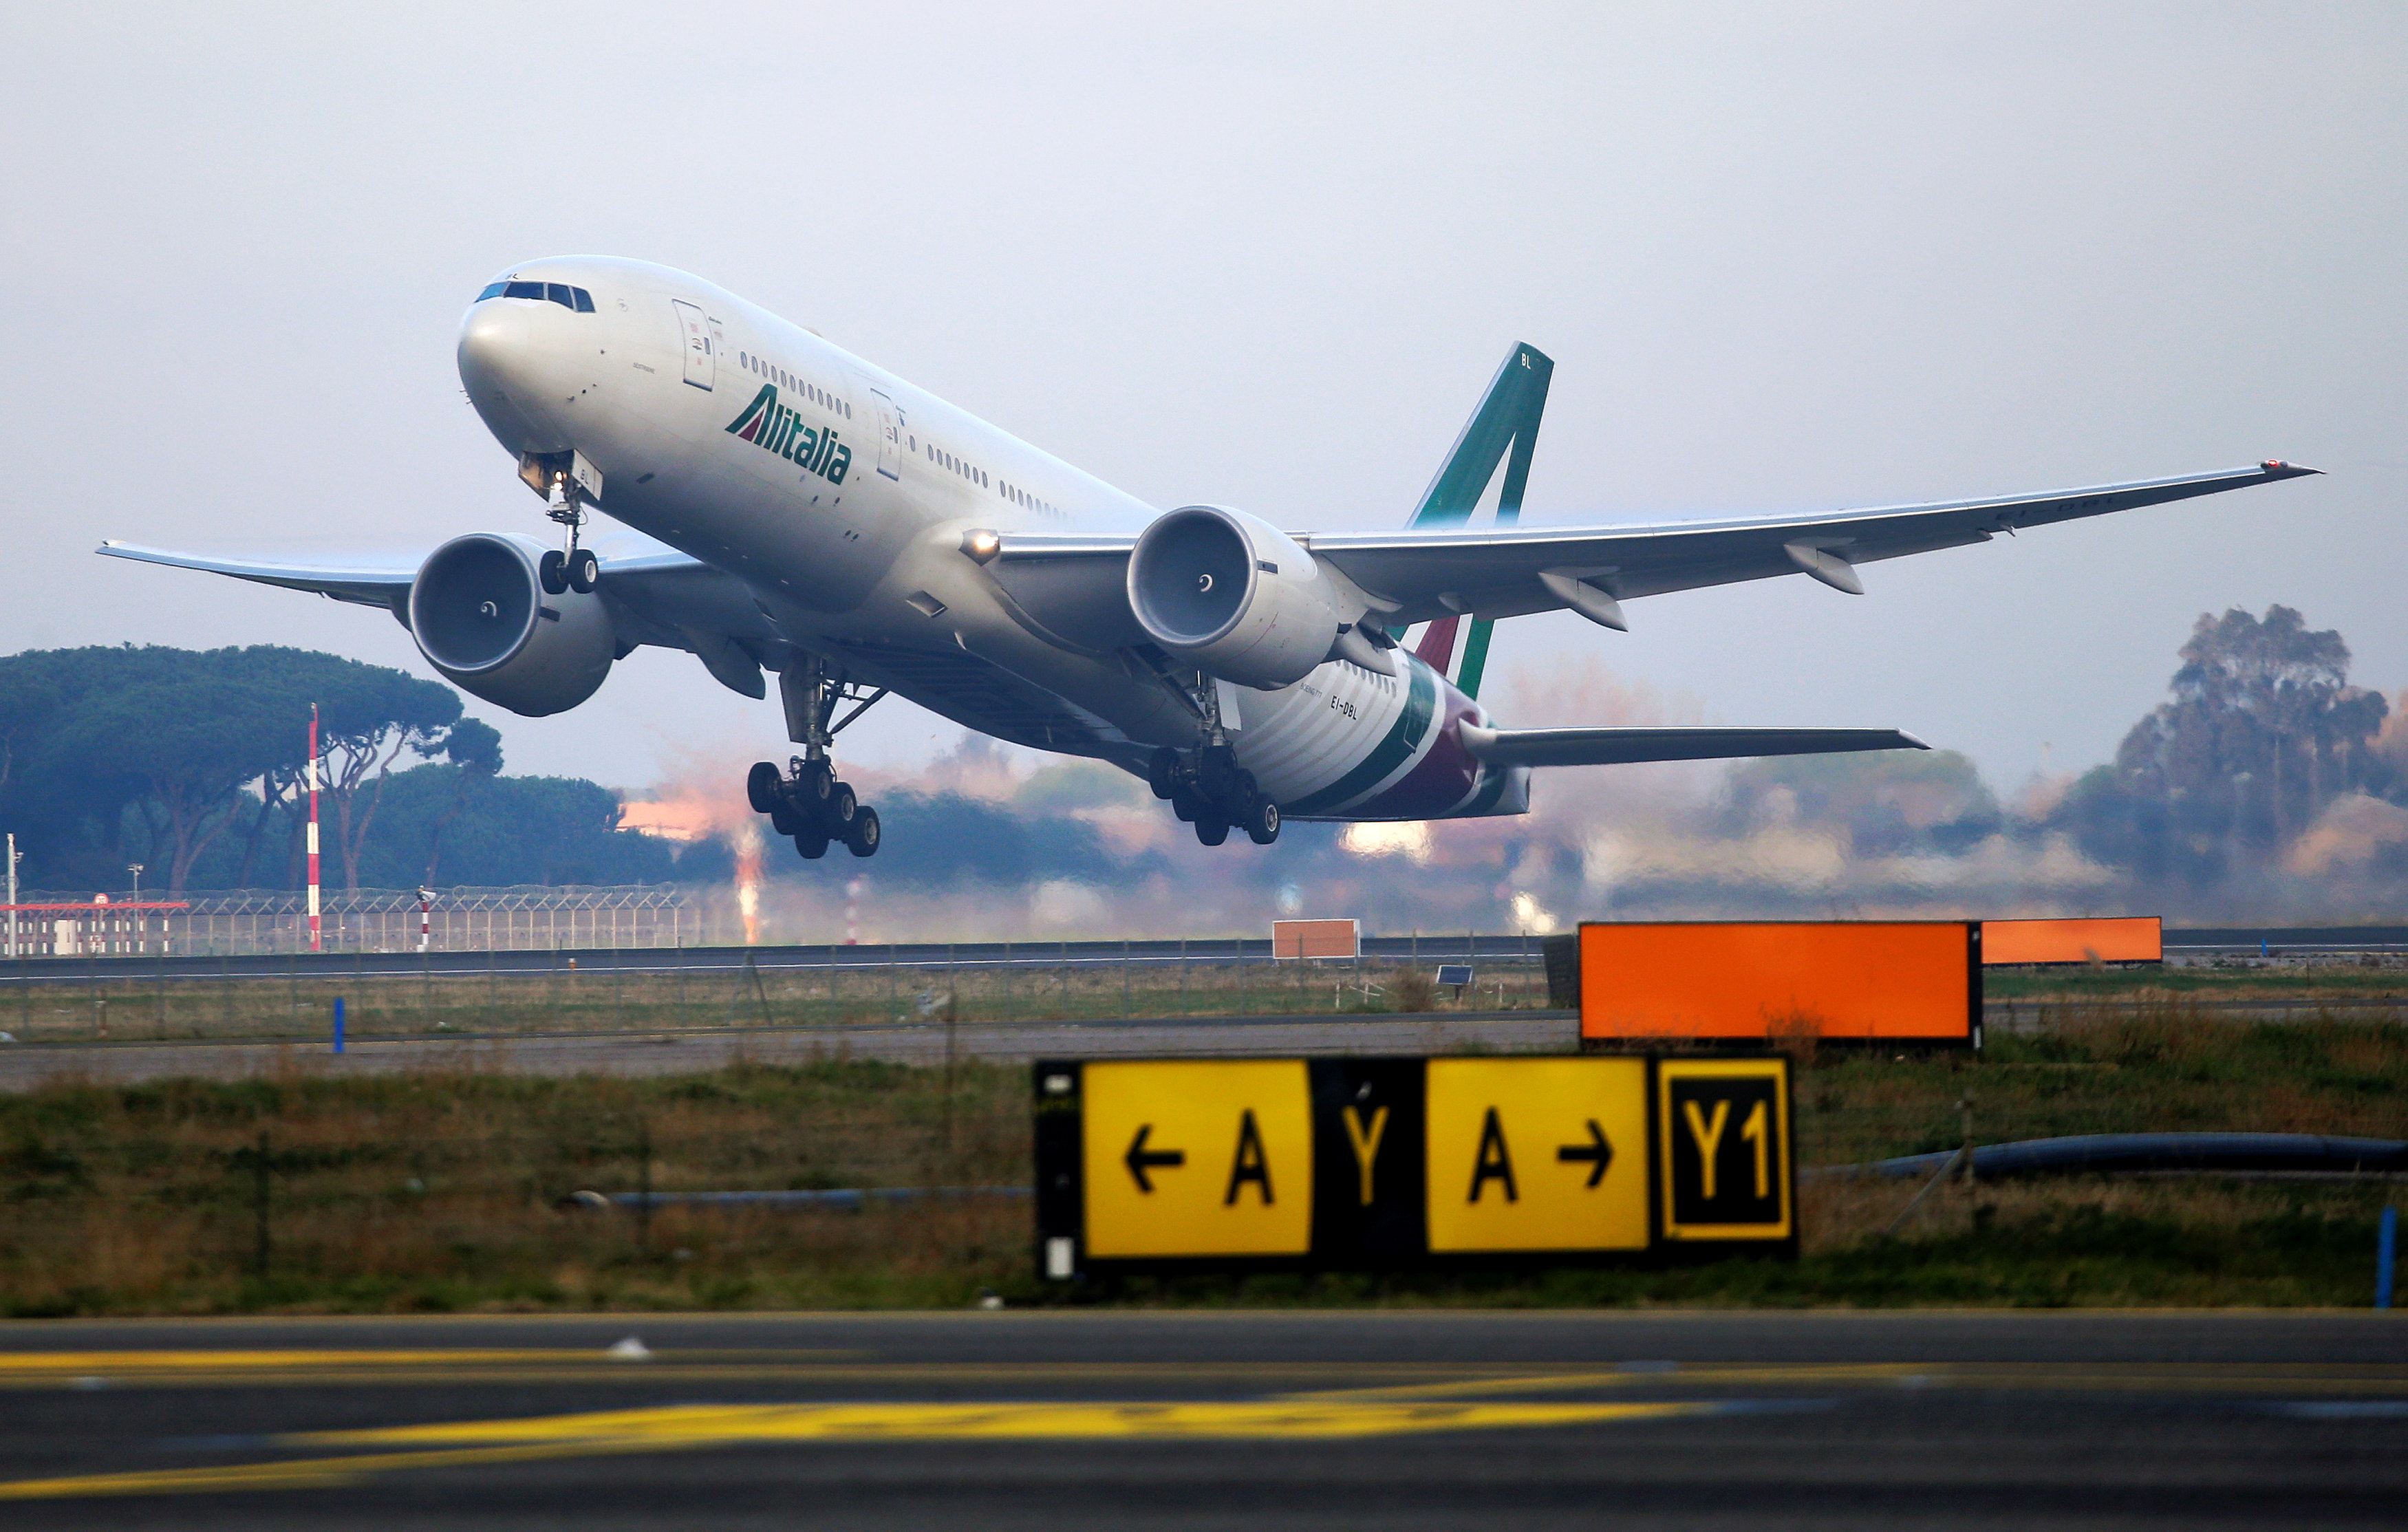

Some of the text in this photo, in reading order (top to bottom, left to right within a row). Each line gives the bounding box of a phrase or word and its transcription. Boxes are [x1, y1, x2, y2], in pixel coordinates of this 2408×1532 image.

[1521, 352, 1531, 369] BL
[724, 383, 852, 486] Alitalia
[1331, 695, 1357, 720] EI-DBL
[1224, 1100, 1769, 1206] A Y A Y1
